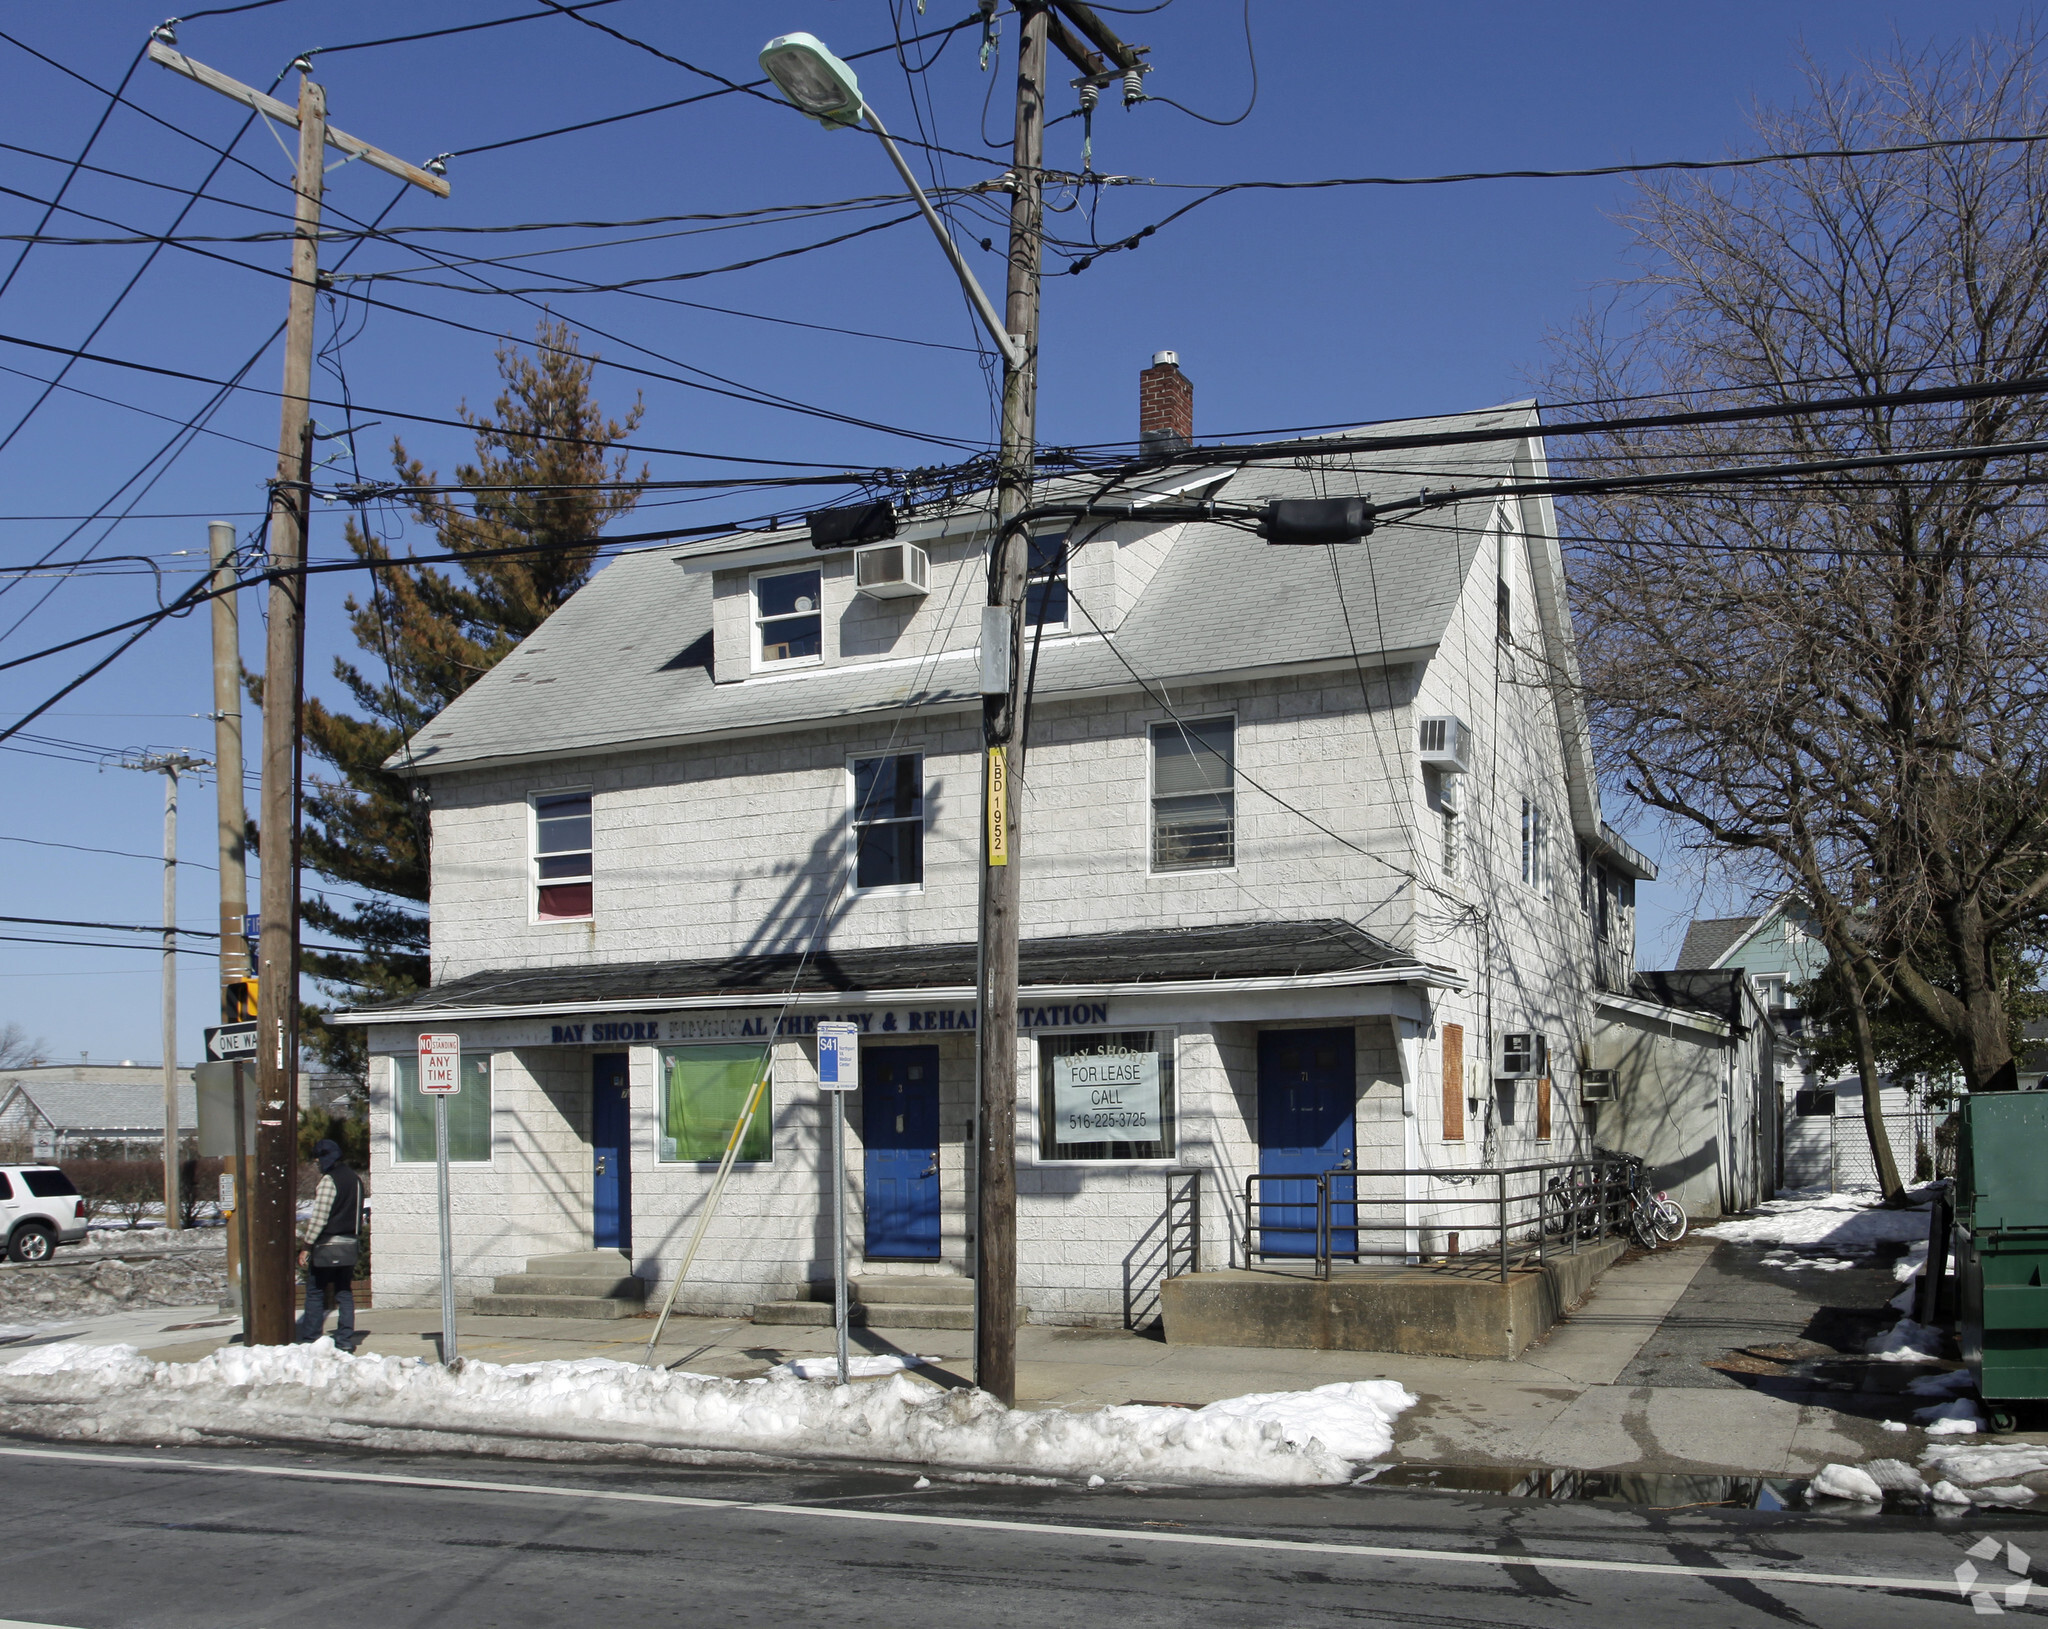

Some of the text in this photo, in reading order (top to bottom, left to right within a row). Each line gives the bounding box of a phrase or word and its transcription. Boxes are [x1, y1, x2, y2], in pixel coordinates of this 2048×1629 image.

[993, 756, 1003, 850] LBD 1952
[551, 1024, 586, 1043] BAY
[592, 1021, 659, 1041] SHORE
[882, 1011, 898, 1032] &
[908, 1003, 1107, 1030] REHATATION
[219, 1034, 257, 1051] ONE WA
[420, 1039, 457, 1051] NO STANDING
[820, 1038, 838, 1051] S41
[429, 1056, 450, 1067] ANY
[1063, 1045, 1149, 1069] BAY SHORE
[427, 1069, 453, 1081] TIME
[1071, 1065, 1141, 1082] FOR LEASE
[1091, 1089, 1123, 1105] CALL
[1069, 1112, 1147, 1129] 516-225-3725
